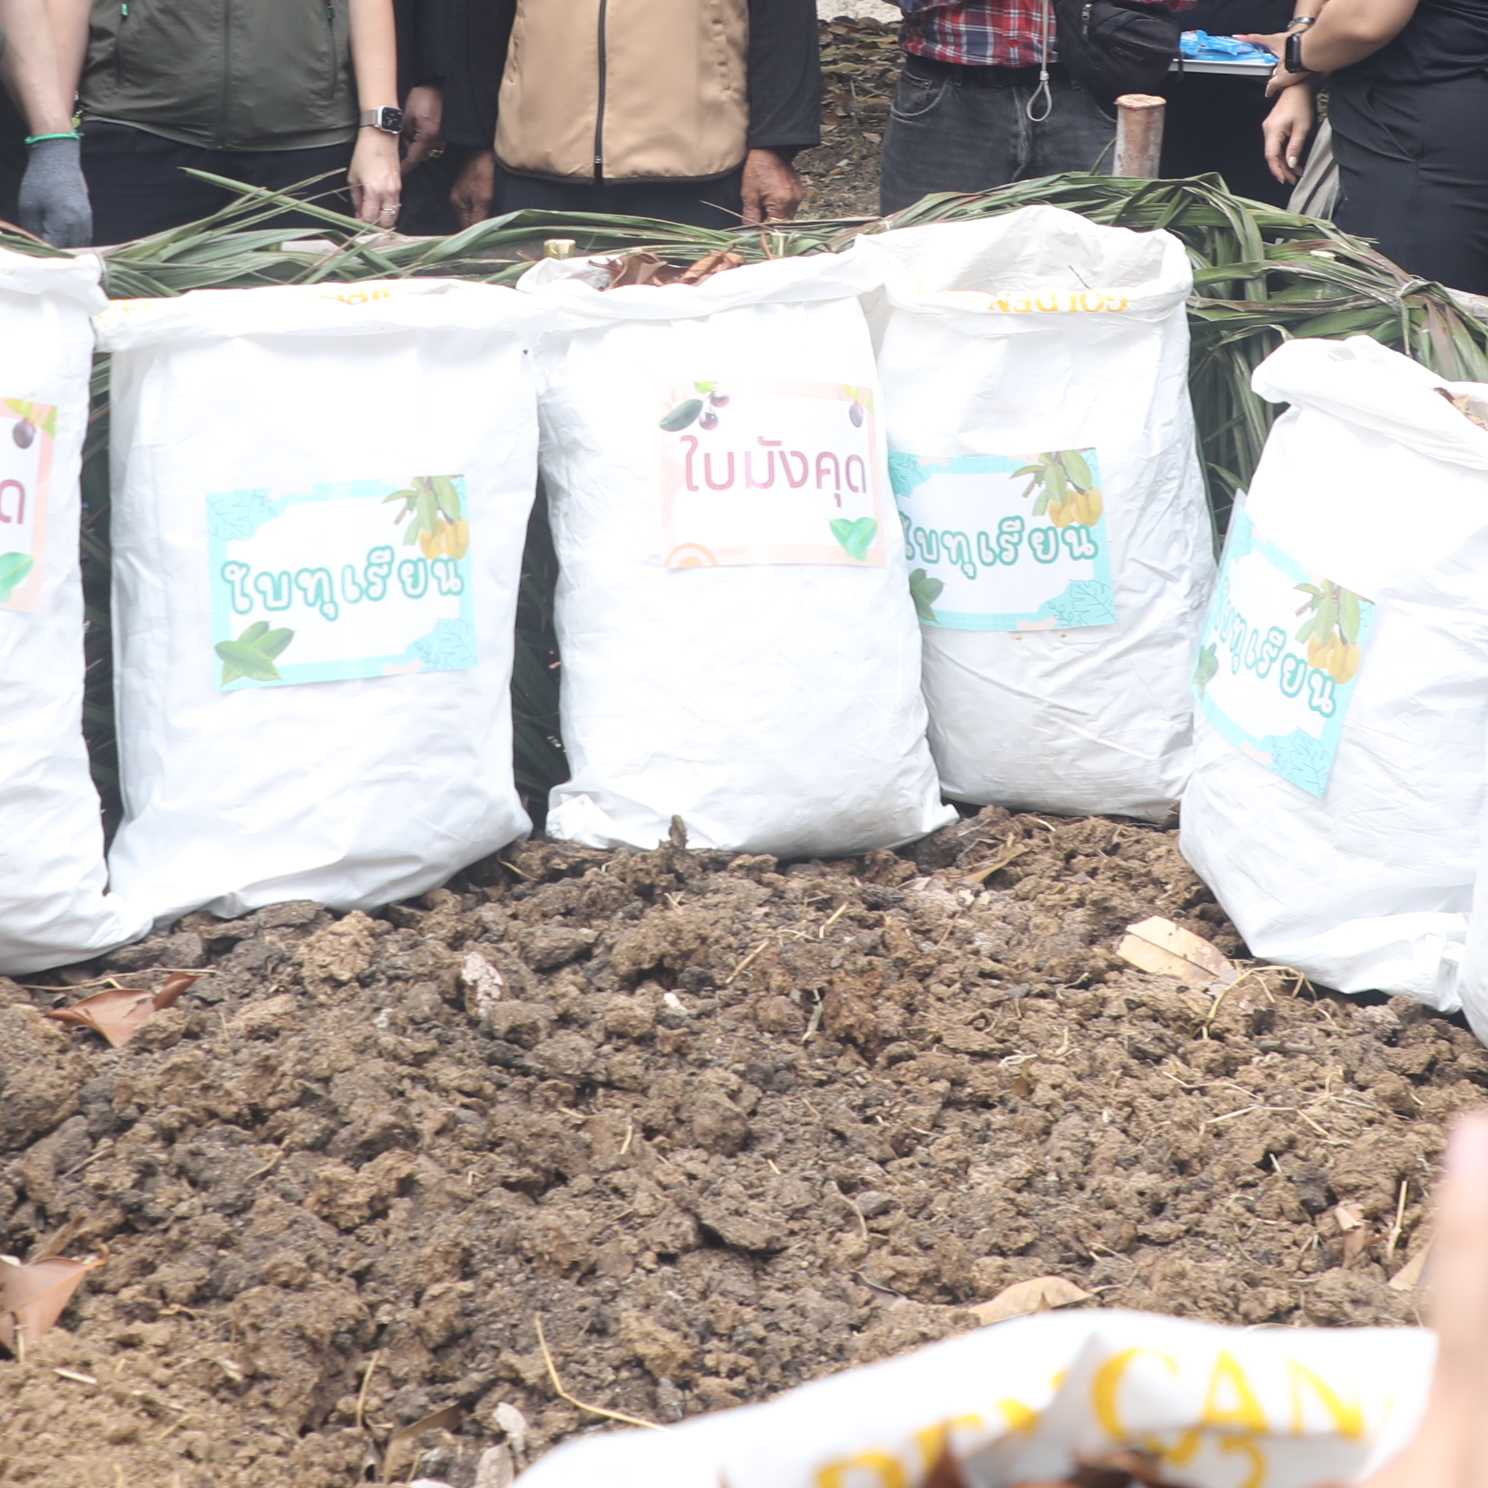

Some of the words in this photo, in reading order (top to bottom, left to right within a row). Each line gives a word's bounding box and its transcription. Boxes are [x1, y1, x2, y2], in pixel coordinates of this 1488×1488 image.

[681, 435, 868, 508] ใบมังคุด
[221, 545, 466, 622] ใบทุเรียน
[1090, 1347, 1395, 1443] CAN
